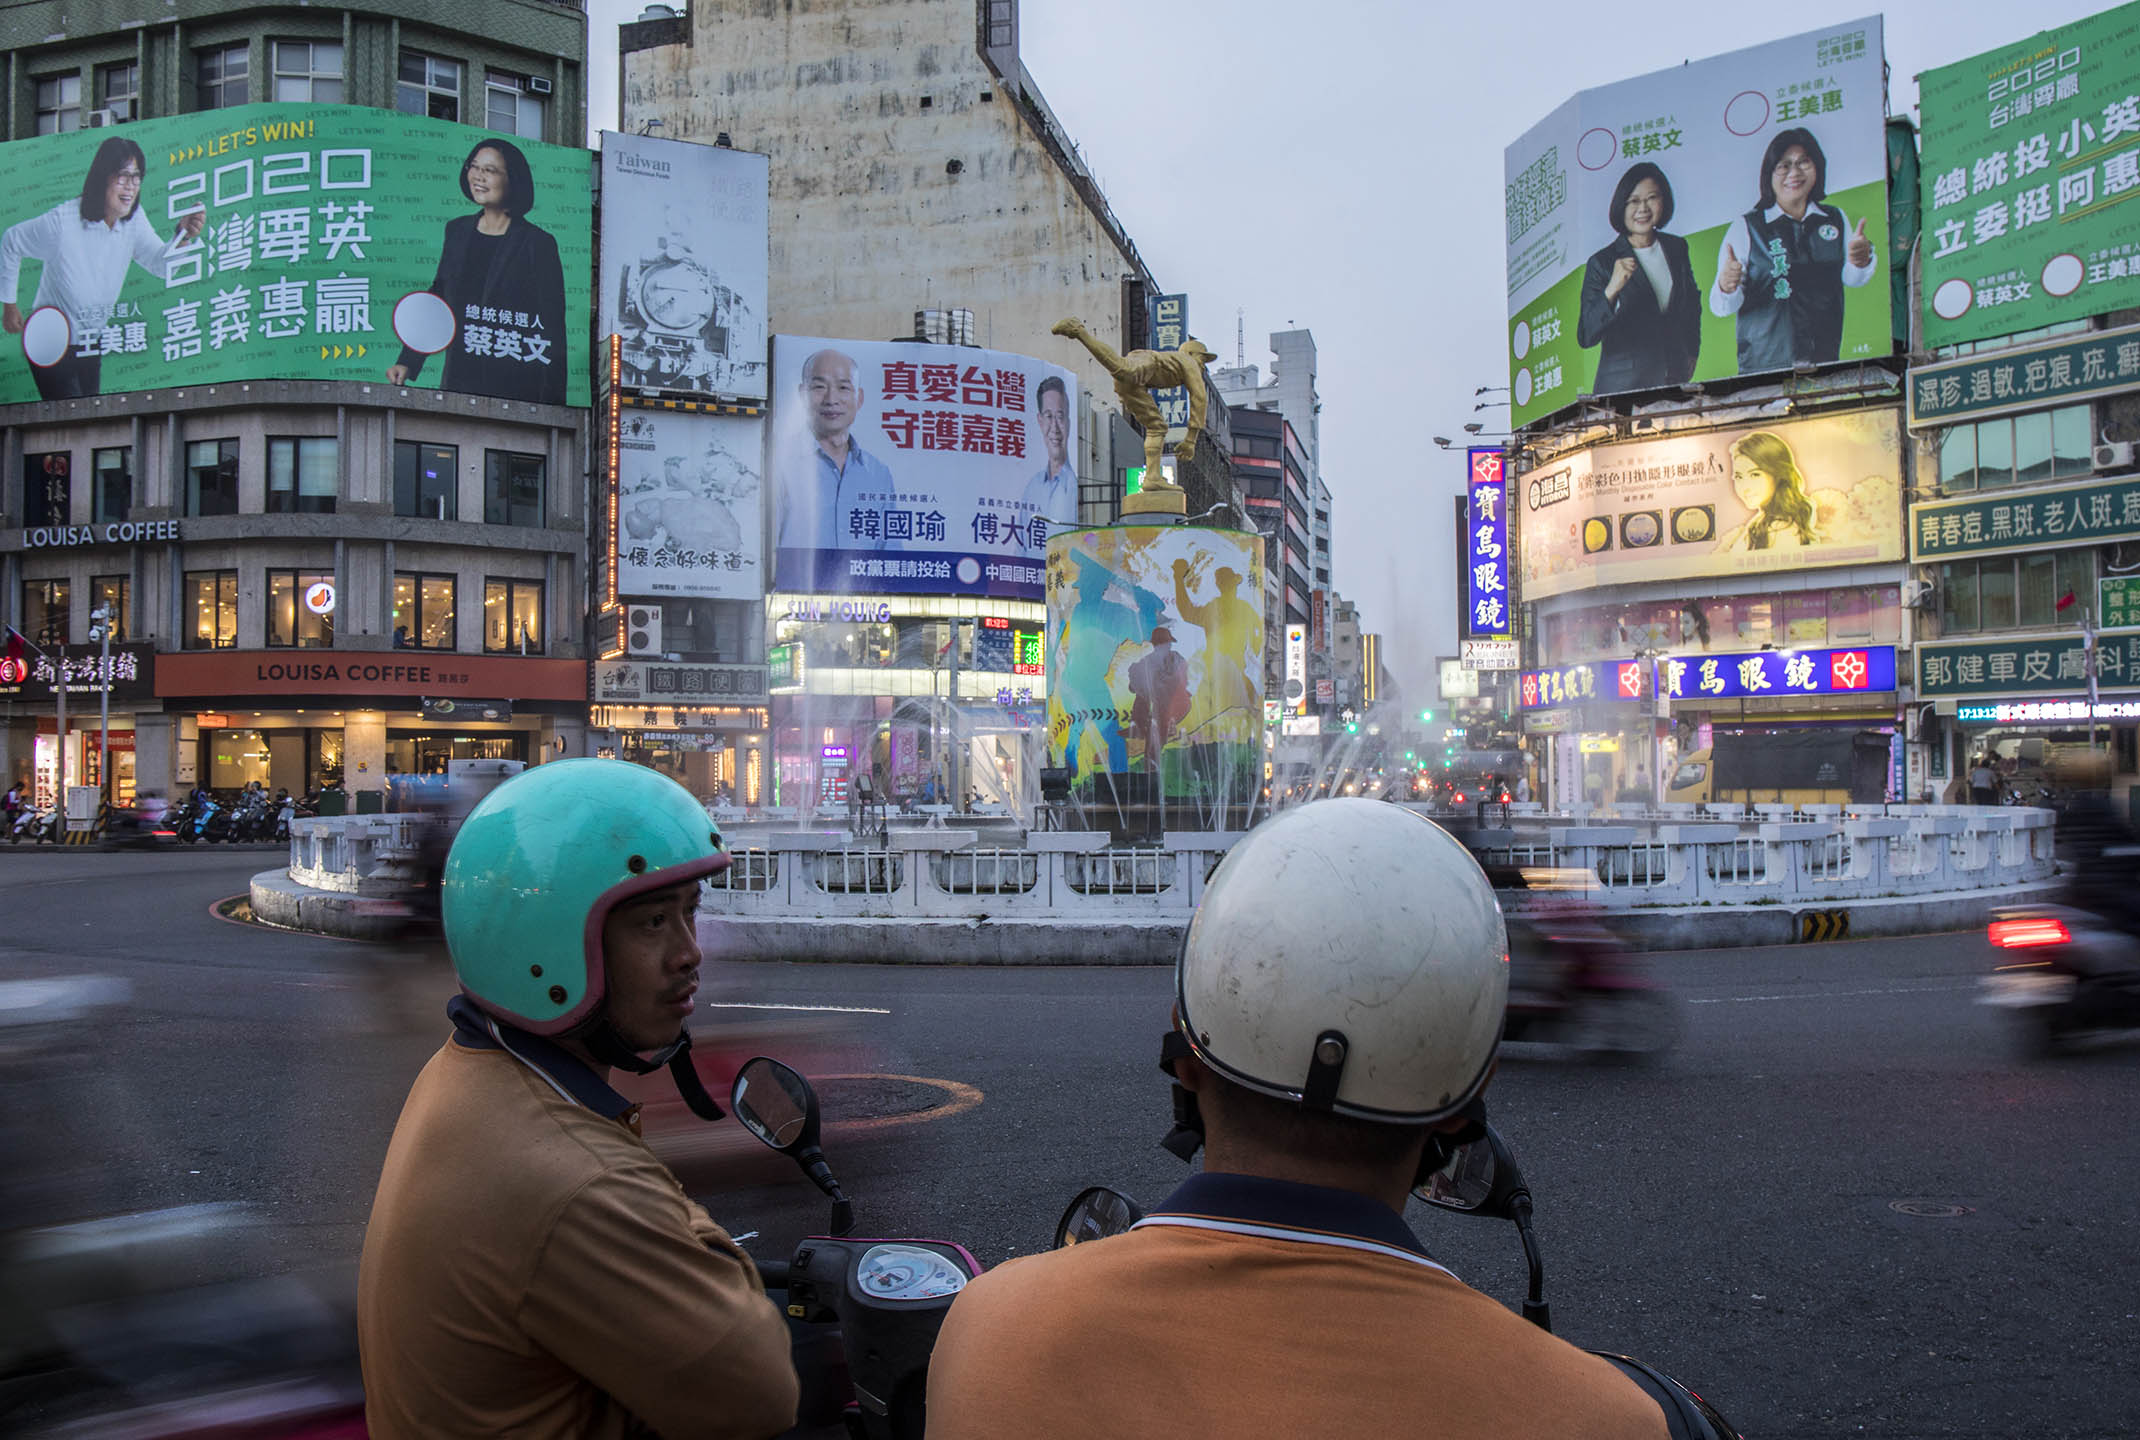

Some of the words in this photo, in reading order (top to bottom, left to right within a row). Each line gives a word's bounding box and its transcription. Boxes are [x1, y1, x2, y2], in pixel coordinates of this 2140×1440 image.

[1817, 30, 1866, 48] 2020
[1817, 56, 1843, 68] LET'S
[1845, 51, 1867, 62] WIN!
[1988, 46, 2081, 101] 2020
[2008, 56, 2033, 73] LET'S
[2035, 45, 2058, 60] WIN!
[1776, 76, 1837, 98] 立委候選人
[1775, 89, 1843, 124] 王美惠
[208, 128, 257, 157] LET'S
[263, 120, 314, 142] WIN!
[1622, 115, 1677, 135] 總統候選人
[1622, 128, 1683, 159] 蔡英文
[1933, 95, 2140, 210] 總統投小英
[615, 151, 671, 173] Taiwan
[168, 149, 371, 219] 2020
[1933, 149, 2140, 260] 立委挺阿惠
[1768, 238, 1793, 299] 王美惠
[1976, 281, 2032, 308] 蔡英文
[162, 271, 376, 362] 嘉義惠贏
[466, 304, 544, 330] 總統候選人
[76, 322, 148, 358] 王美惠
[463, 323, 552, 365] 蔡英文
[1532, 318, 1561, 350] 蔡英文
[881, 361, 1026, 412] 真愛台灣
[1534, 366, 1562, 397] 王美惠
[881, 409, 1026, 459] 守護嘉義
[858, 493, 938, 503] 國民黨總統候選人
[1541, 471, 1568, 494] 海昌
[23, 526, 94, 548] LOUISA
[106, 520, 179, 543] COFFEE
[849, 508, 946, 542] 韓國瑜
[971, 513, 1047, 550] 傅大偉
[850, 559, 951, 578] 政黨票請投給
[1473, 486, 1505, 629] 寶島眼鏡
[788, 601, 820, 620] SUN
[830, 601, 890, 623] YOUNG
[1025, 642, 1039, 653] 46
[1025, 654, 1039, 664] 39
[257, 664, 340, 681] LOUISA
[347, 666, 431, 683] COFFEE
[1668, 655, 1818, 696] 寶島眼鏡
[1924, 646, 2125, 687] 郭健軍皮膚科
[1317, 684, 1333, 694] OK
[1539, 667, 1596, 704] 寶島眼鏡
